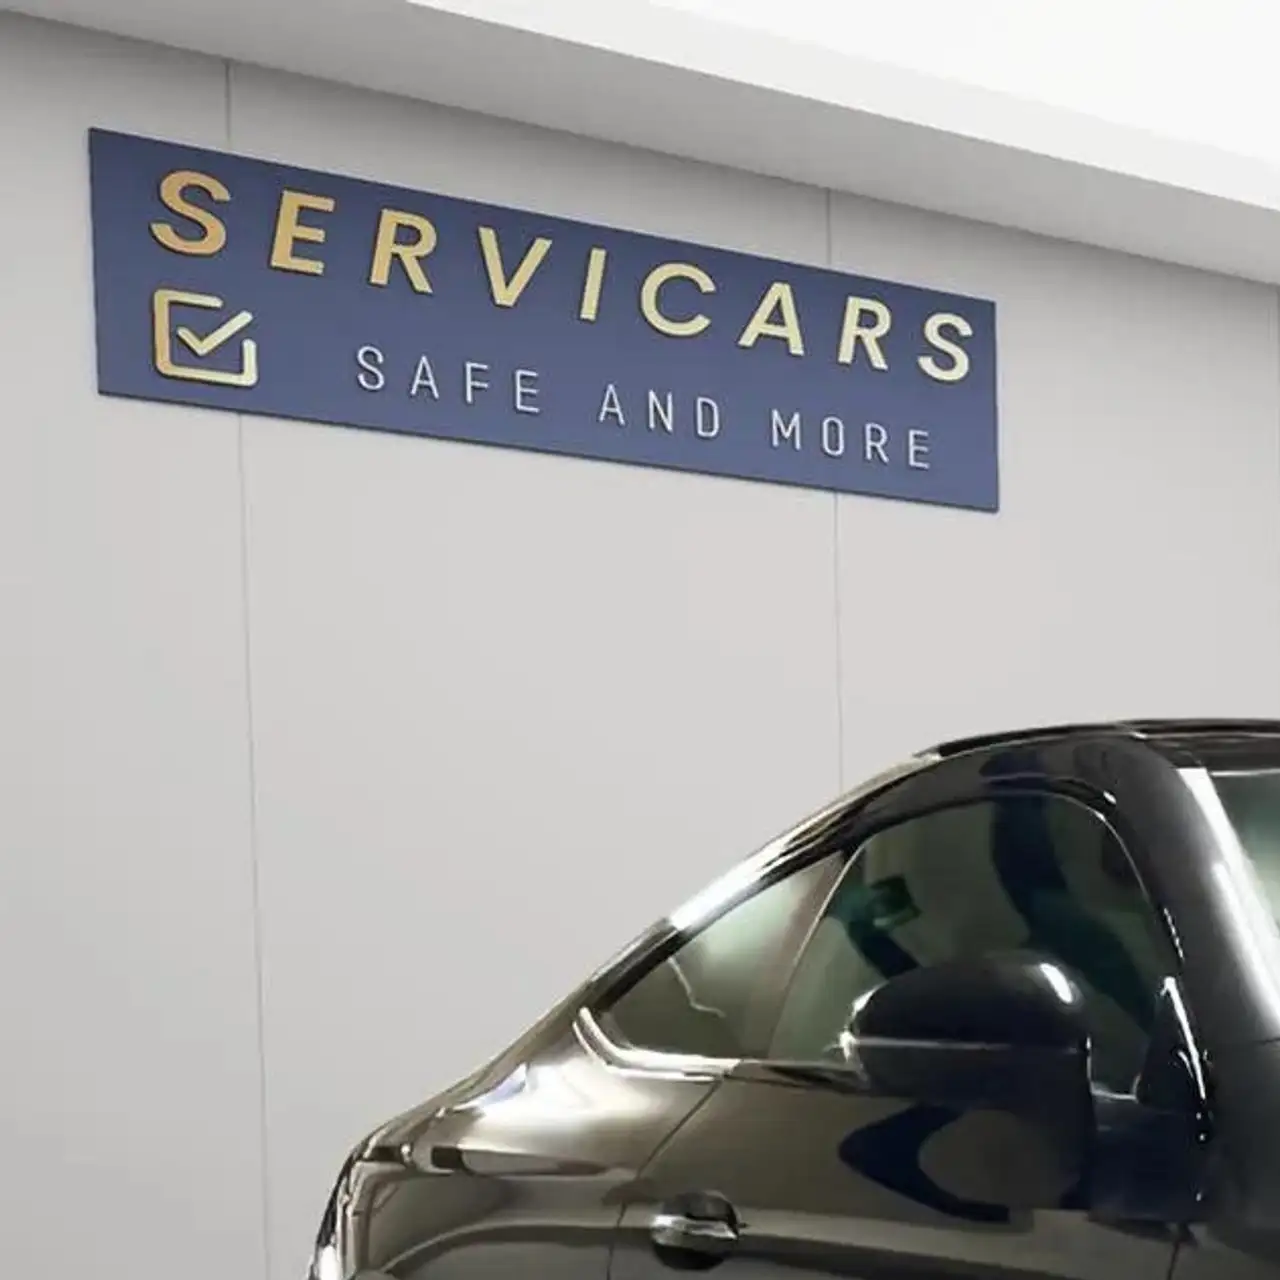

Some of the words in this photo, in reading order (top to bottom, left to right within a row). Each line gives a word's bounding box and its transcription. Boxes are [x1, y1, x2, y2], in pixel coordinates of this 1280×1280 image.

[150, 170, 974, 383] SERVICARS
[356, 344, 542, 414] SAFE
[598, 382, 721, 440] AND
[770, 407, 931, 470] MORE
